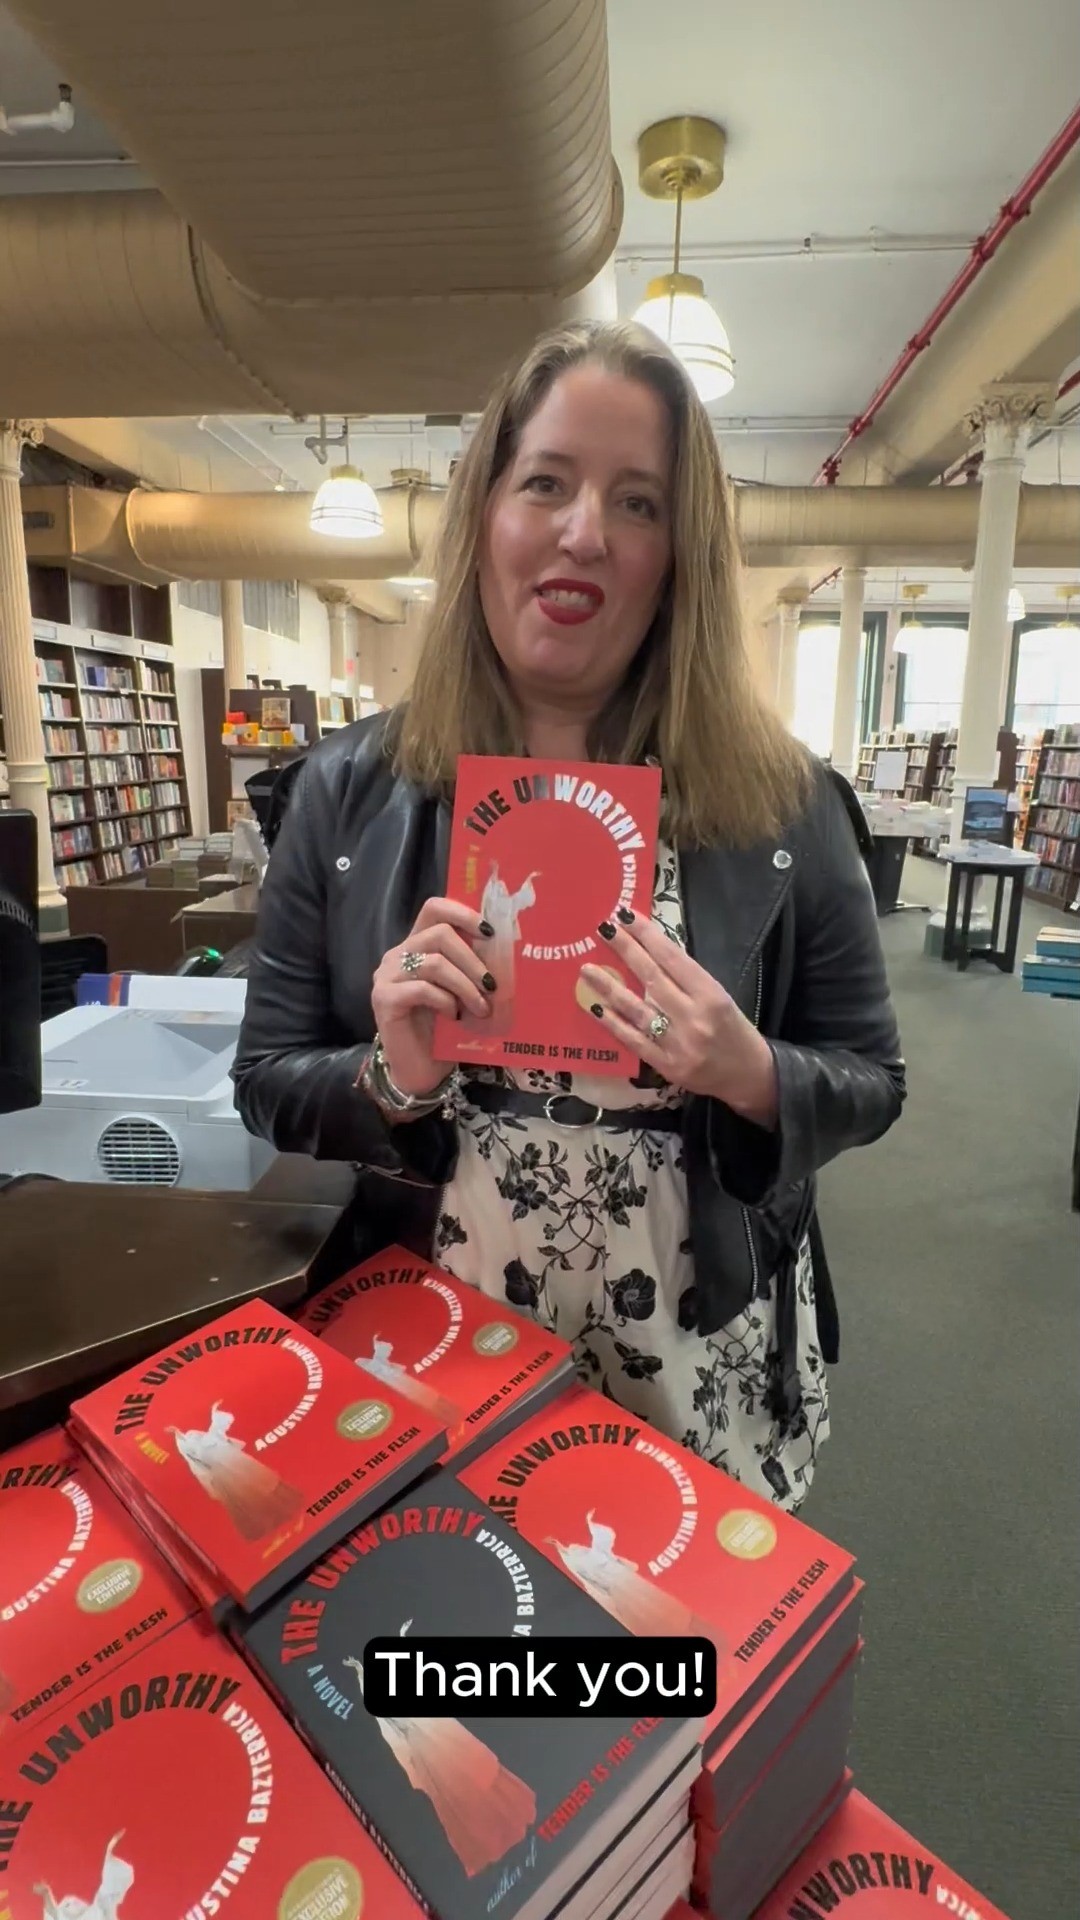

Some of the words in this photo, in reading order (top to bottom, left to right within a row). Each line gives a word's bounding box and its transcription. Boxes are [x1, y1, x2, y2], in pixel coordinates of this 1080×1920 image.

[463, 789, 512, 836] THE
[512, 771, 646, 851] UNWORTHY
[609, 853, 637, 926] ERRICA
[522, 936, 597, 960] AGUSTINA
[503, 1041, 546, 1057] TENDER
[549, 1045, 560, 1058] IS
[563, 1046, 583, 1060] THE
[586, 1048, 620, 1063] FLESH
[309, 1268, 429, 1323] UNWORTHY
[114, 1392, 154, 1435] THE
[140, 1326, 292, 1386] UNWORTHY
[414, 1325, 461, 1374] AGUSTINA
[255, 1393, 319, 1451] AGUSTINA
[465, 1394, 502, 1425] TENDER
[500, 1385, 512, 1397] IS
[508, 1371, 529, 1387] THE
[526, 1350, 553, 1373] FLESH
[0, 1463, 78, 1490] RTHY
[306, 1479, 354, 1518] TENDER
[351, 1466, 367, 1481] IS
[364, 1450, 389, 1471] THE
[387, 1426, 421, 1454] FLESH
[497, 1423, 642, 1488] UNWORTHY
[475, 1528, 535, 1616] BAZTERRICA
[647, 1509, 698, 1577] AGUSTINA
[0, 1557, 77, 1621] GUSTINA
[280, 1599, 327, 1665] THE
[304, 1505, 487, 1591] UNWORTHY
[734, 1619, 776, 1664] TENDER
[773, 1606, 787, 1623] IS
[781, 1584, 804, 1611] THE
[798, 1558, 830, 1592] FLESH
[10, 1674, 75, 1723] TENDER
[76, 1660, 93, 1677] IS
[93, 1640, 124, 1664] THE
[124, 1606, 169, 1643] FLESH
[307, 1664, 324, 1677] A
[313, 1676, 355, 1721] NOVEL
[18, 1670, 242, 1786] UNWORTHY
[180, 1835, 261, 1920] USTINA
[222, 1701, 274, 1824] BAZTERRICA
[536, 1779, 595, 1843] TENDER
[590, 1762, 611, 1784] IS
[787, 1851, 935, 1920] NWORTHY
